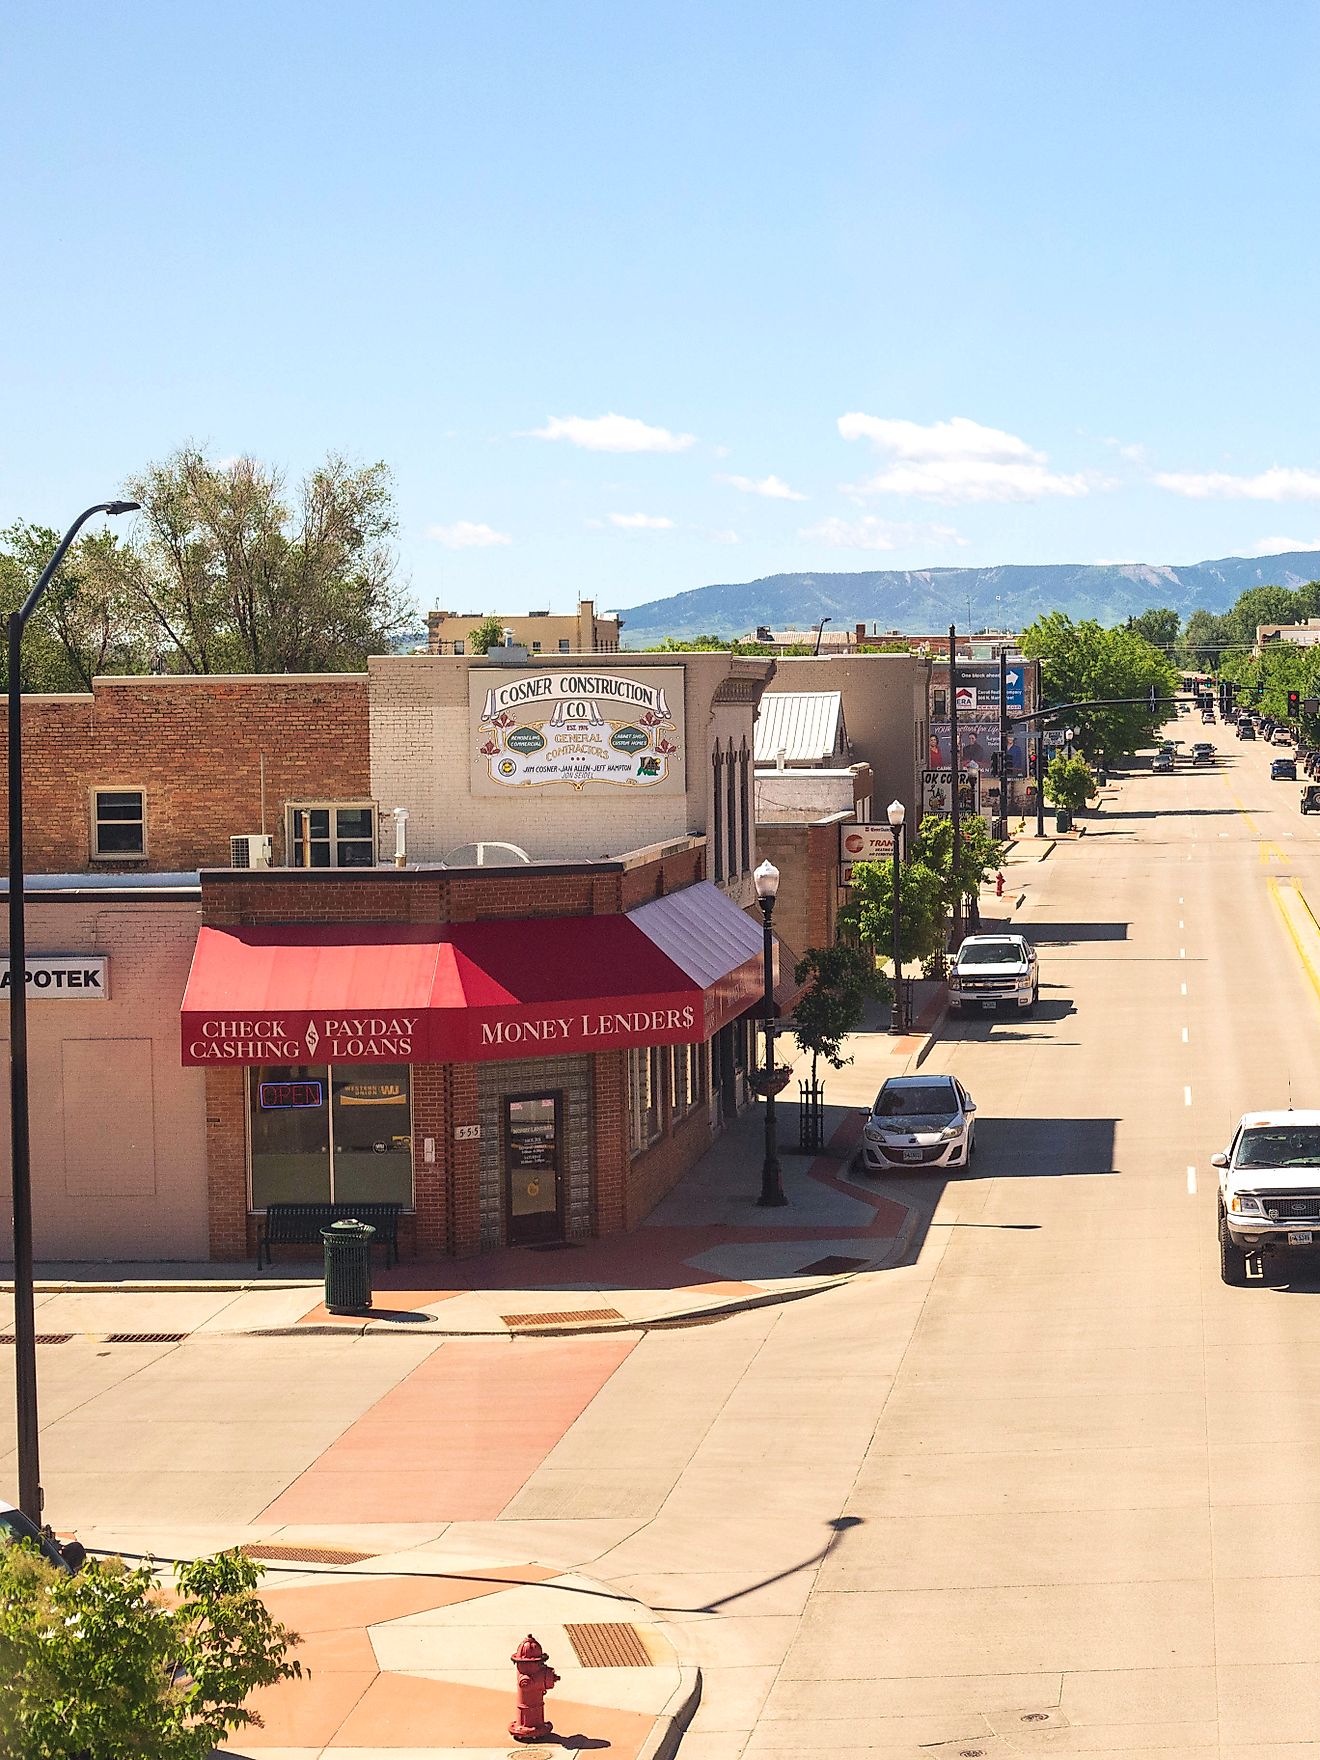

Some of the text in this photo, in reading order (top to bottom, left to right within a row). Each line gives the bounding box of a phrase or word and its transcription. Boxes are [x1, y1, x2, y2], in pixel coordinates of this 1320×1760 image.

[500, 676, 653, 706] COSNER CONSTRUCTION
[566, 702, 588, 718] CO.
[554, 733, 603, 743] GENERAL
[545, 745, 610, 762] CONTRACTORS
[925, 773, 938, 784] OK
[869, 839, 894, 847] TRAN
[202, 1020, 287, 1038] CHECK
[324, 1018, 419, 1037] PAYDAY
[480, 1017, 574, 1045] MONEY
[581, 1005, 694, 1036] LENDER$
[189, 1041, 300, 1059] CASHING
[332, 1038, 412, 1057] LOANS
[263, 1085, 319, 1106] OPEN
